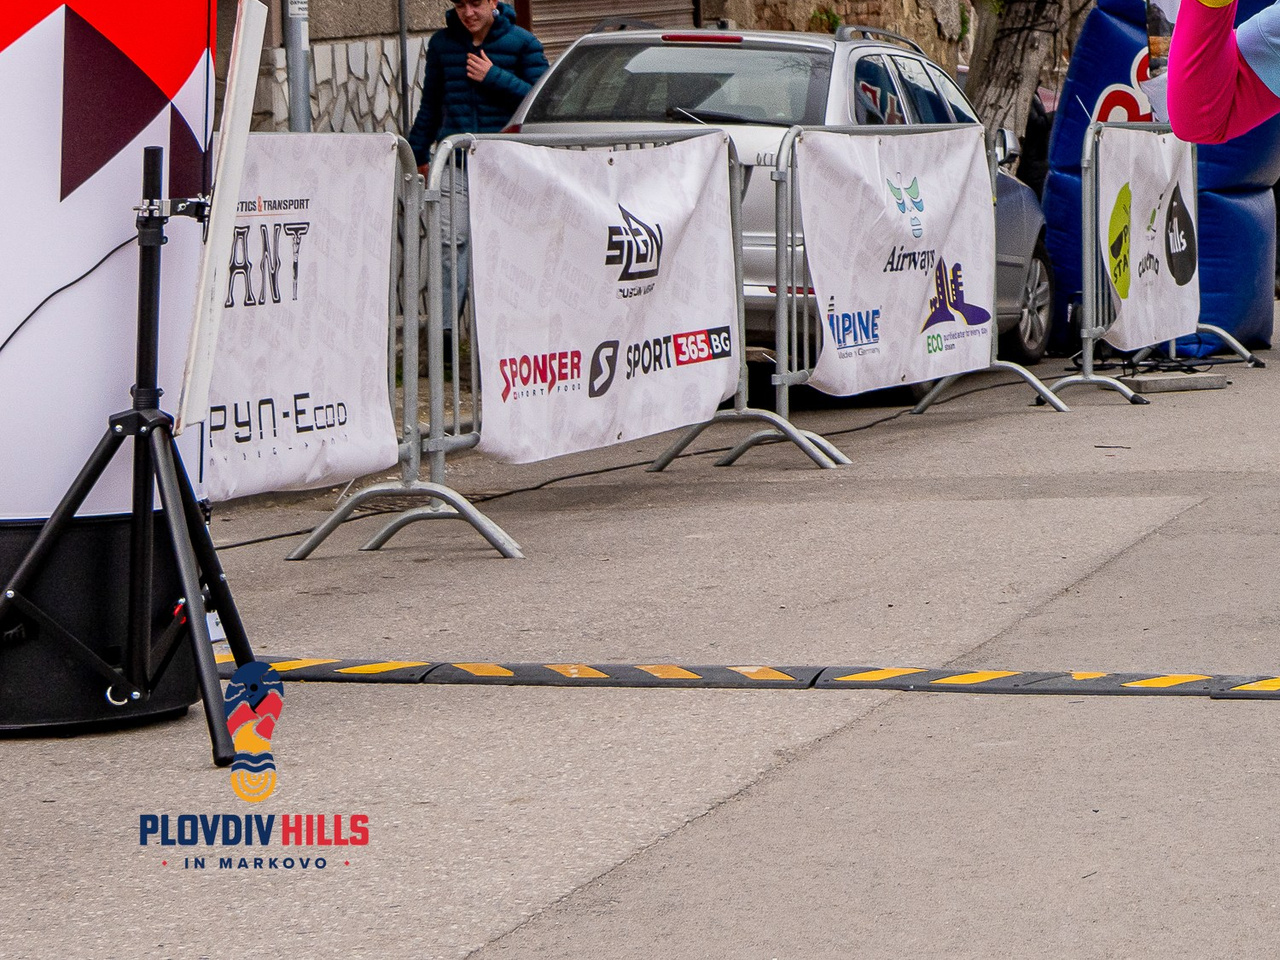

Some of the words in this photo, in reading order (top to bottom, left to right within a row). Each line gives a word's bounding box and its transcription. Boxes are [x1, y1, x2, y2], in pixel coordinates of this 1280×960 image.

[883, 246, 935, 276] Airways
[927, 333, 943, 354] ECO
[500, 350, 582, 403] SPONSER
